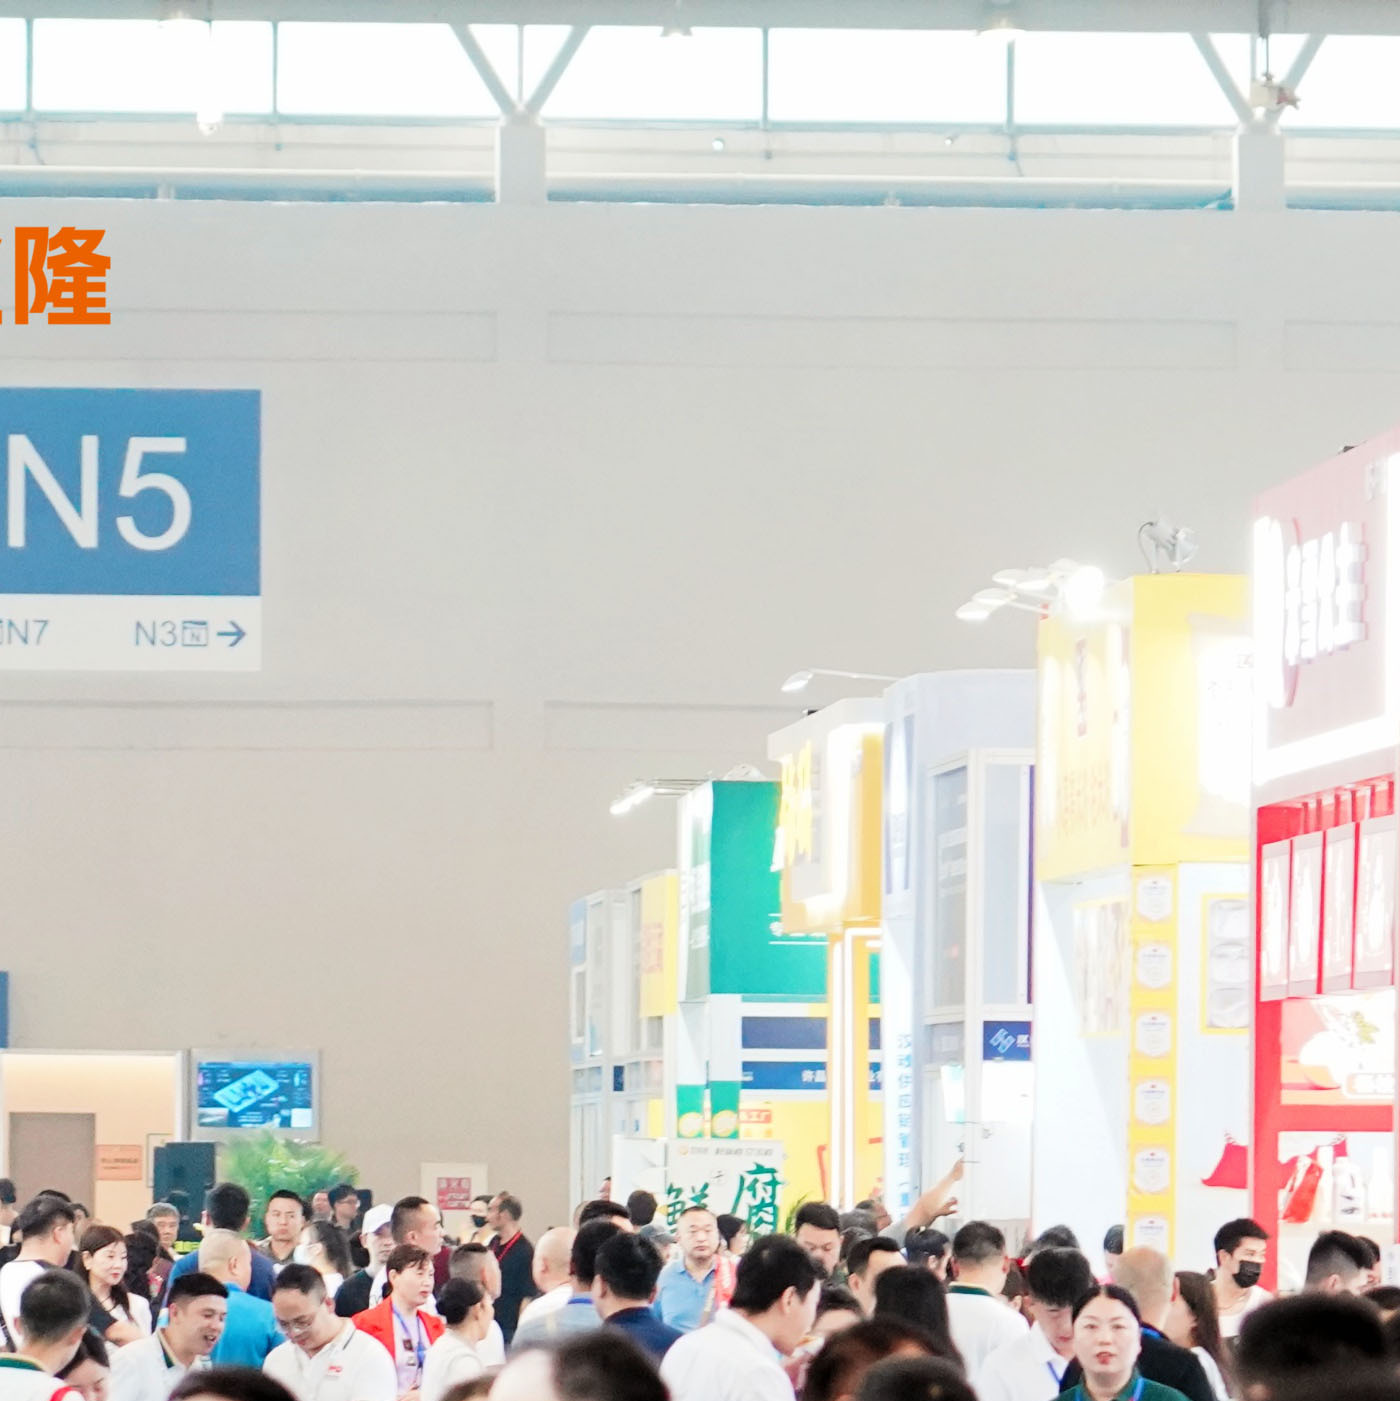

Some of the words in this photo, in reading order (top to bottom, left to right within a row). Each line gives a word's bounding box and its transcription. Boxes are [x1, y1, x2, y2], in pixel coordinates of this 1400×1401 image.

[7, 434, 192, 551] N5
[7, 618, 49, 646] N7
[135, 620, 177, 647] N3
